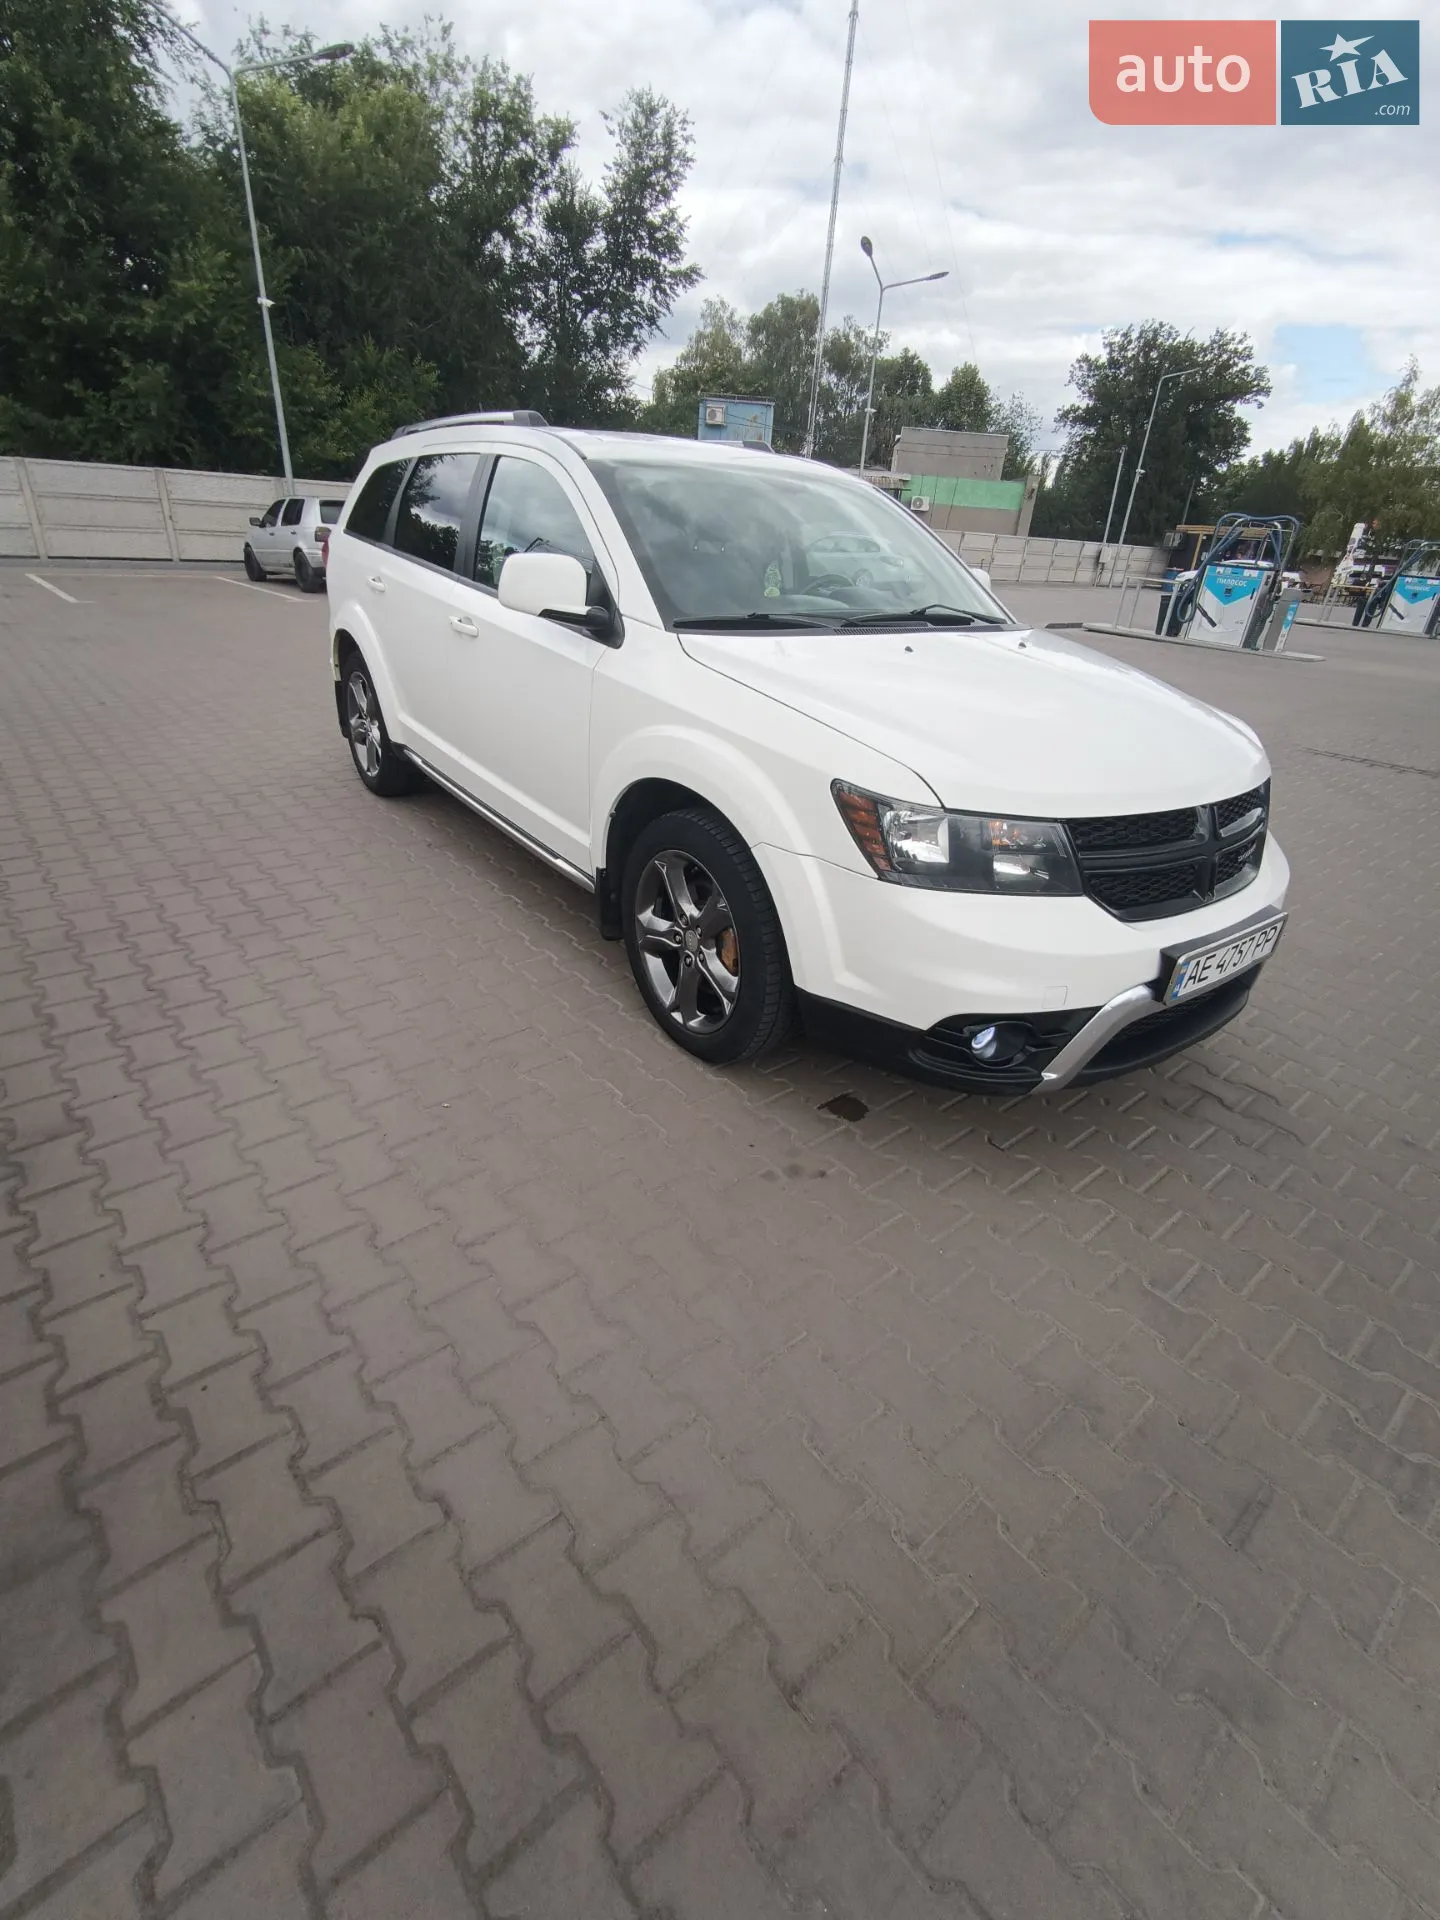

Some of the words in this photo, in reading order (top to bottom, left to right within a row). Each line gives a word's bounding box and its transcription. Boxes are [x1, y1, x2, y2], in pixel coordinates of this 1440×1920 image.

[1183, 954, 1217, 989] AE
[1216, 936, 1255, 975] 4757
[1252, 925, 1278, 957] PP
